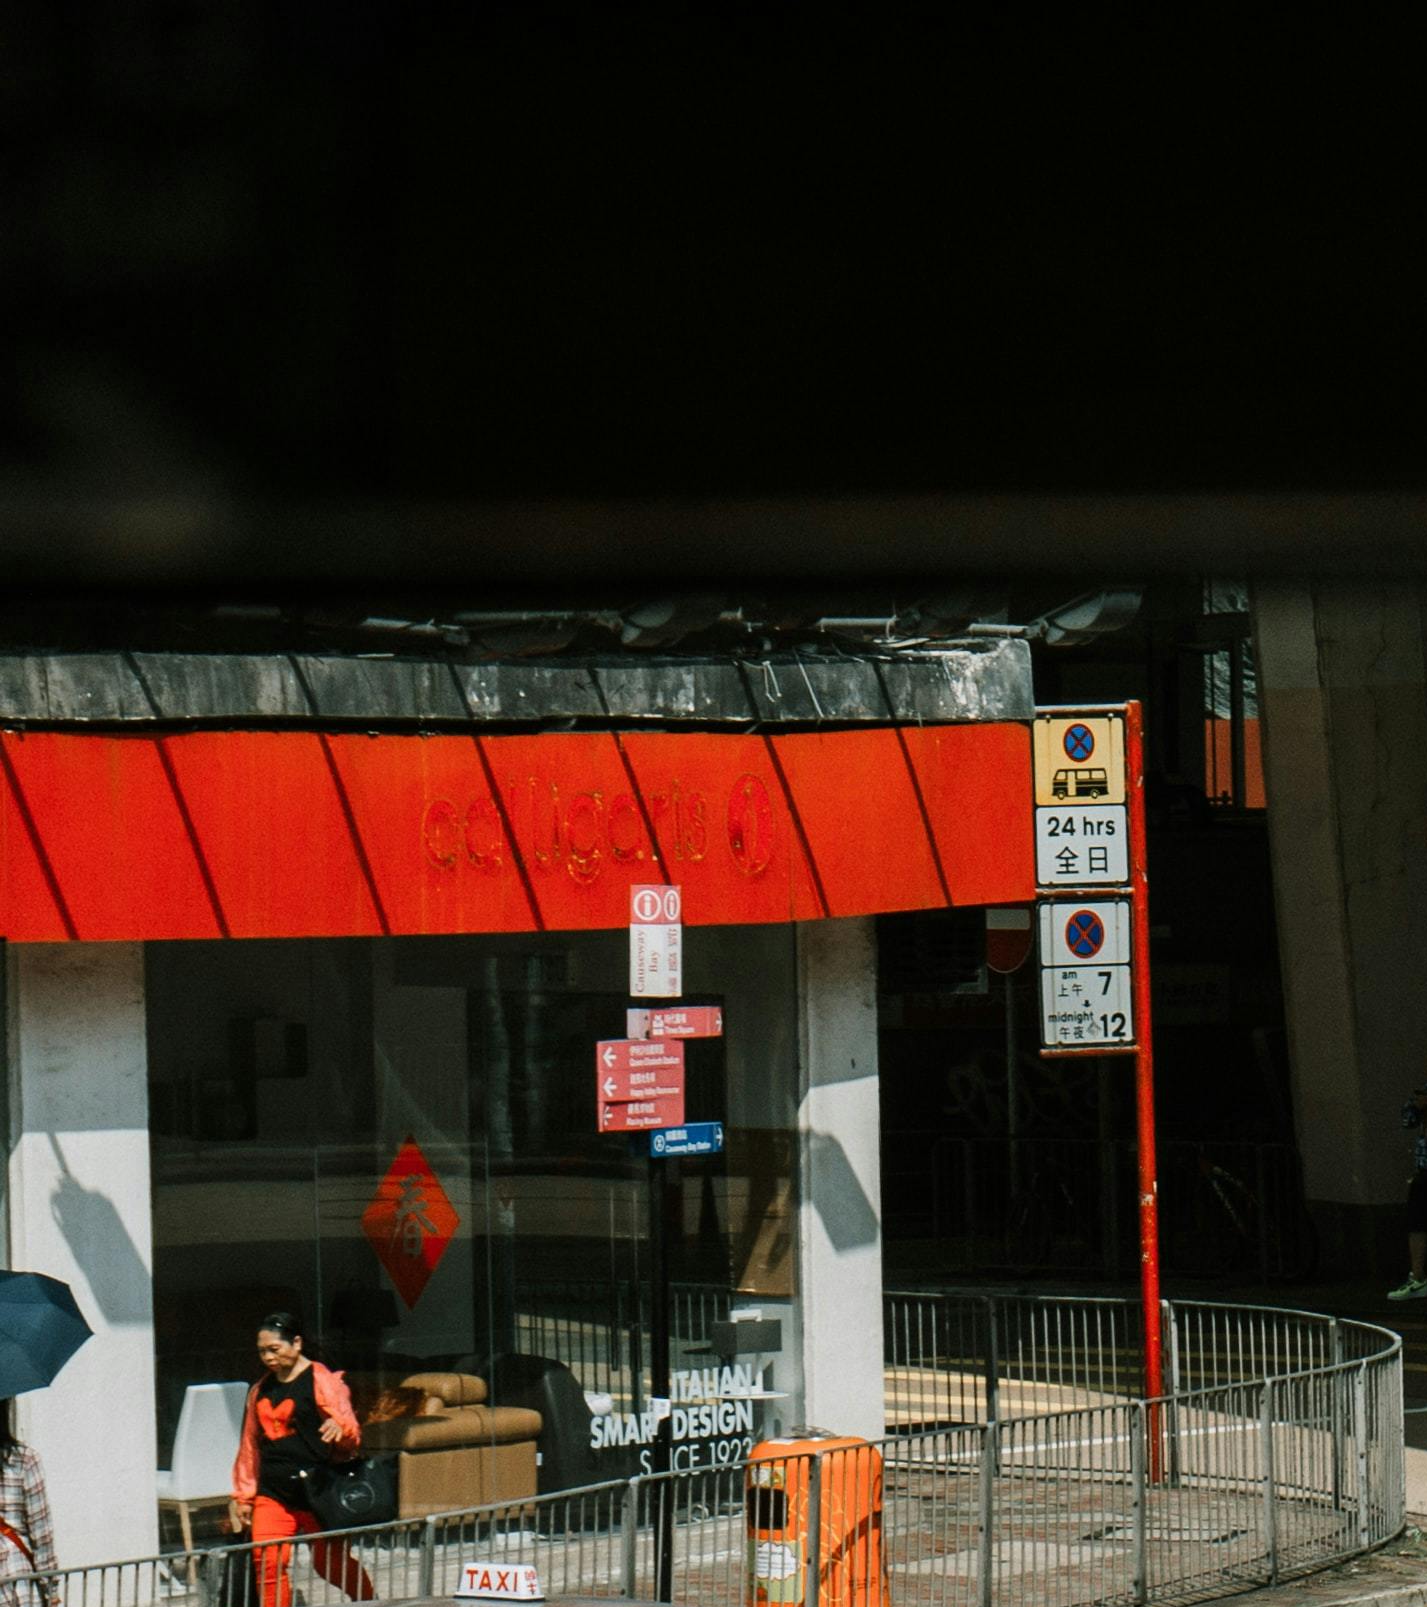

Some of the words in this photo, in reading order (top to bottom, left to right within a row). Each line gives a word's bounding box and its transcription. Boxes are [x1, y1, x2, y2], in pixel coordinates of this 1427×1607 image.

[1047, 816, 1076, 837] 24
[1083, 816, 1116, 836] hrs
[1055, 846, 1108, 875] 全日
[635, 929, 646, 993] Causeway
[648, 951, 661, 973] Bay
[1061, 970, 1078, 980] am
[1098, 971, 1112, 996] 7
[1057, 983, 1083, 998] 上午
[1048, 1011, 1094, 1024] midnight
[1100, 1012, 1126, 1038] 12
[1059, 1026, 1085, 1039] 午夜
[391, 1174, 439, 1258] 春
[671, 1363, 752, 1402] ITALIAN
[590, 1411, 658, 1449] SMAR
[672, 1400, 753, 1441] DESIGN
[639, 1441, 701, 1477] SCE
[466, 1569, 518, 1592] TAXI
